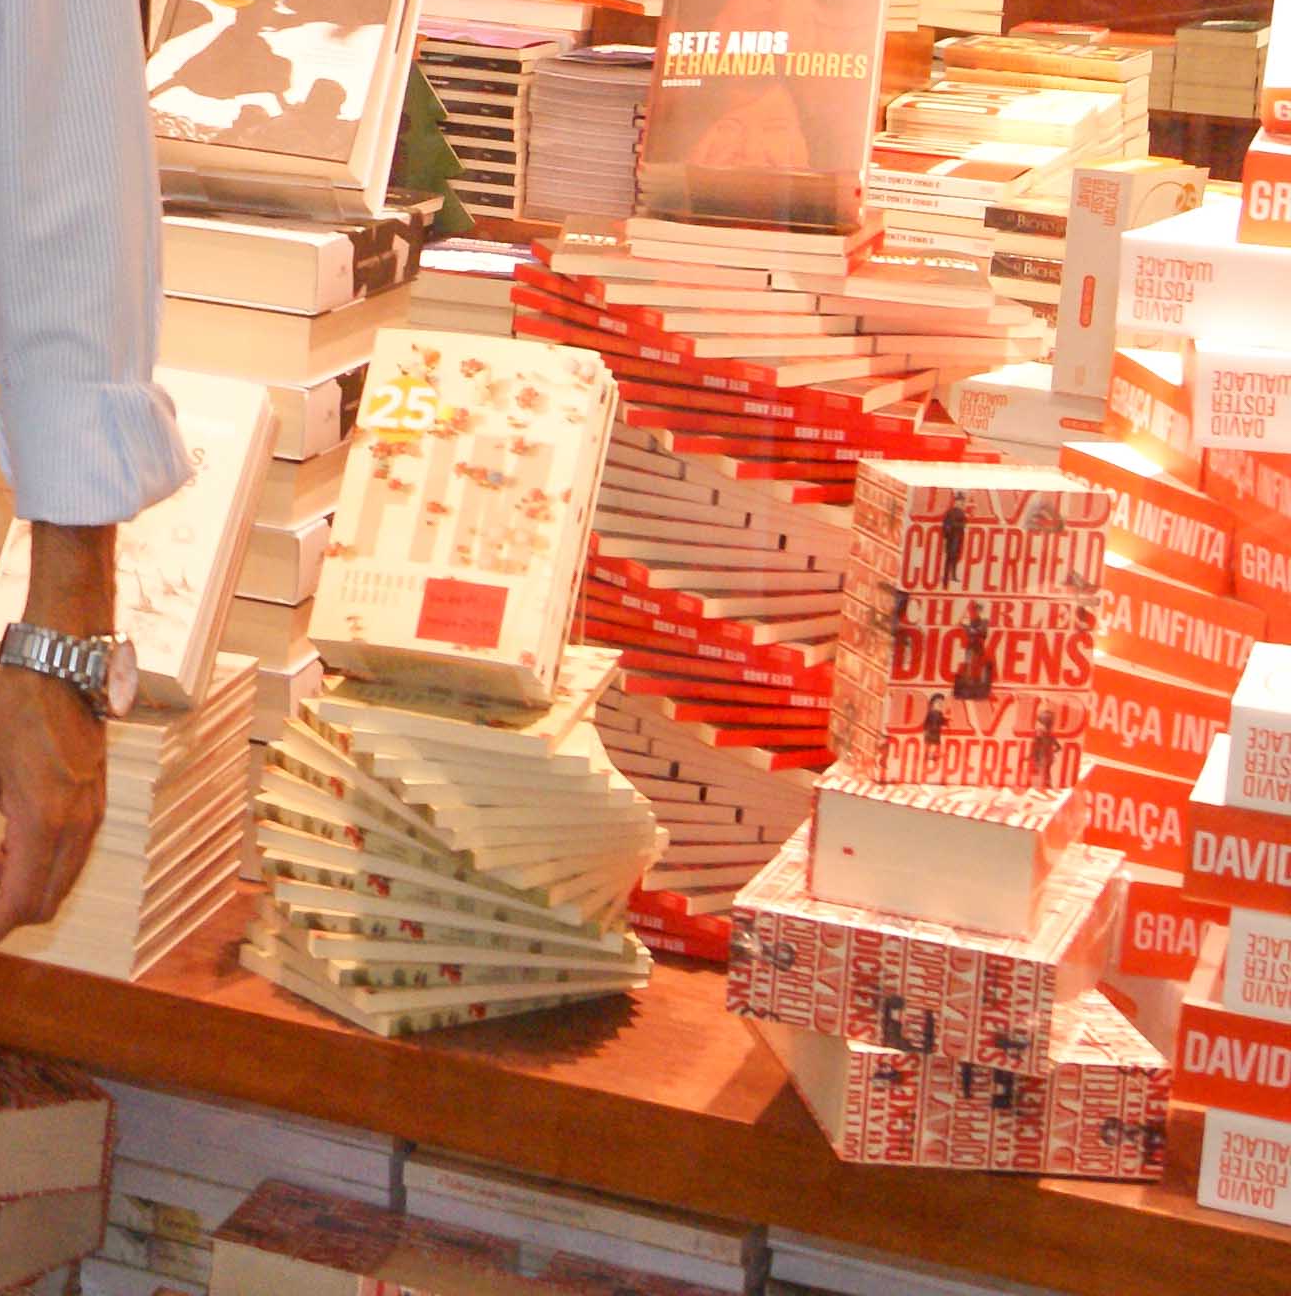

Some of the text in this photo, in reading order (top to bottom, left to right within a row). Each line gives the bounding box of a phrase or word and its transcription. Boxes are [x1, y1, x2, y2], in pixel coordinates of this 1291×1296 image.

[663, 51, 868, 81] FERNANDA TORRES
[667, 30, 789, 56] SETE ANOS
[1134, 281, 1195, 303] FOSTER
[1137, 255, 1214, 283] WALLACE
[1133, 299, 1184, 324] DAVID
[368, 385, 437, 429] 25
[1211, 394, 1276, 417] FOSTER
[1211, 415, 1266, 439] DAVID
[908, 487, 1111, 529] DAVID
[1134, 499, 1228, 570] INFINITA
[891, 627, 1095, 686] DICKENS
[1139, 600, 1256, 672] INFINITA
[1192, 829, 1291, 887] DAVID
[815, 923, 846, 1033] DAVID
[847, 930, 882, 1042] DICKENS
[942, 948, 975, 1059] DAVID
[978, 953, 1016, 1067] DICKENS
[1183, 1029, 1291, 1090] DAVID
[885, 1054, 918, 1162] DICKENS
[1051, 1064, 1079, 1171] DAVID
[1079, 1065, 1117, 1174] COPPERFIELD
[1217, 1178, 1276, 1210] DAVID
[1219, 1154, 1290, 1187] FOSTER
